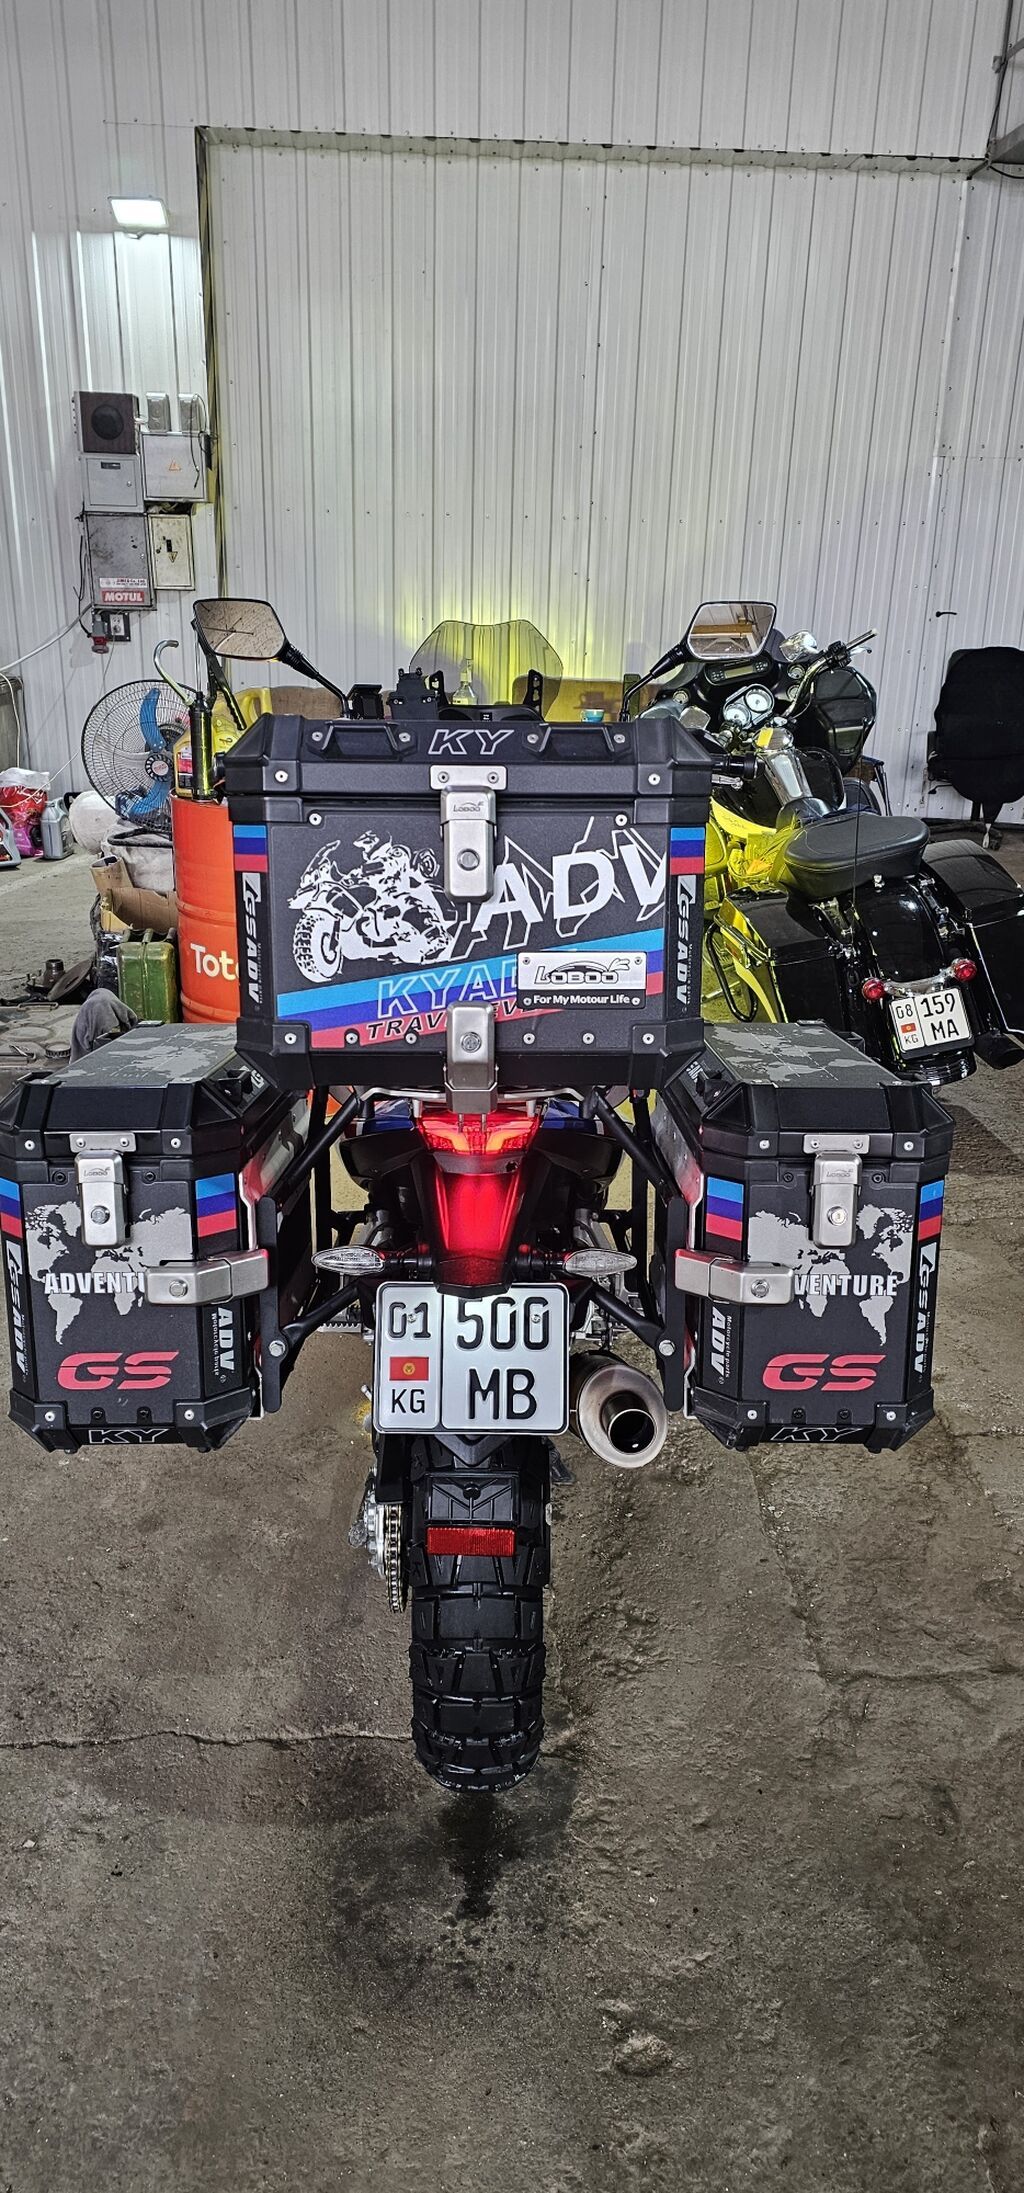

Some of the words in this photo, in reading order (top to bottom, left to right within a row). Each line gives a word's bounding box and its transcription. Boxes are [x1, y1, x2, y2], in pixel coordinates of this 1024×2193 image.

[104, 592, 143, 602] MOTUL
[428, 729, 514, 755] KY
[190, 942, 239, 981] Tot
[533, 995, 552, 1004] For
[553, 995, 570, 1006] My
[571, 995, 609, 1004] Motour
[610, 995, 630, 1004] Life
[895, 1003, 913, 1020] 08
[920, 993, 956, 1018] 159
[903, 1033, 919, 1044] KG
[931, 1019, 960, 1041] MA
[794, 1274, 898, 1296] VENTURE
[387, 1302, 432, 1339] 01
[456, 1297, 549, 1351] 500
[725, 1315, 733, 1357] Motorcycle
[57, 1351, 180, 1390] GS
[763, 1353, 887, 1391] GS
[390, 1388, 425, 1414] KG
[468, 1369, 538, 1420] MB
[89, 1428, 169, 1444] KY
[771, 1427, 863, 1442] KY
